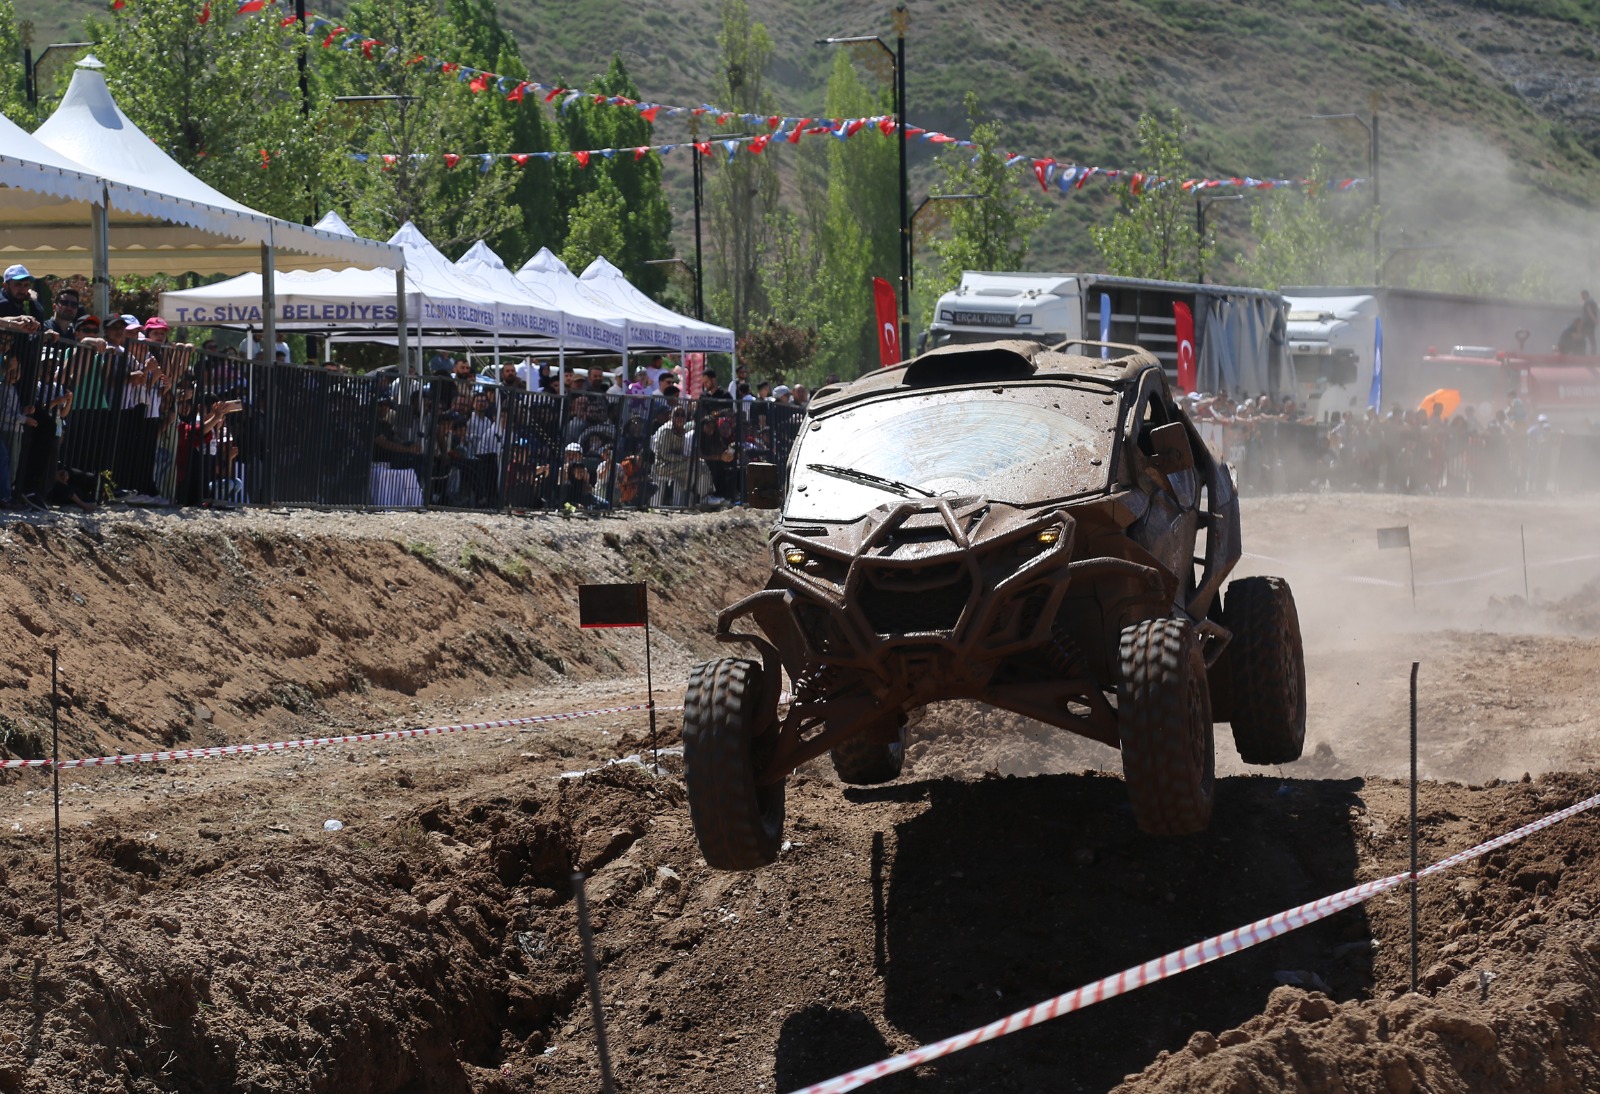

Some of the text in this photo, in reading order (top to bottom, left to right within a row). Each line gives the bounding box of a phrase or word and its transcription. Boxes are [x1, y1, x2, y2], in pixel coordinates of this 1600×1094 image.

[176, 301, 399, 322] T.C.SİVA BELEDİYES
[457, 305, 494, 326] BELEDİYESİ
